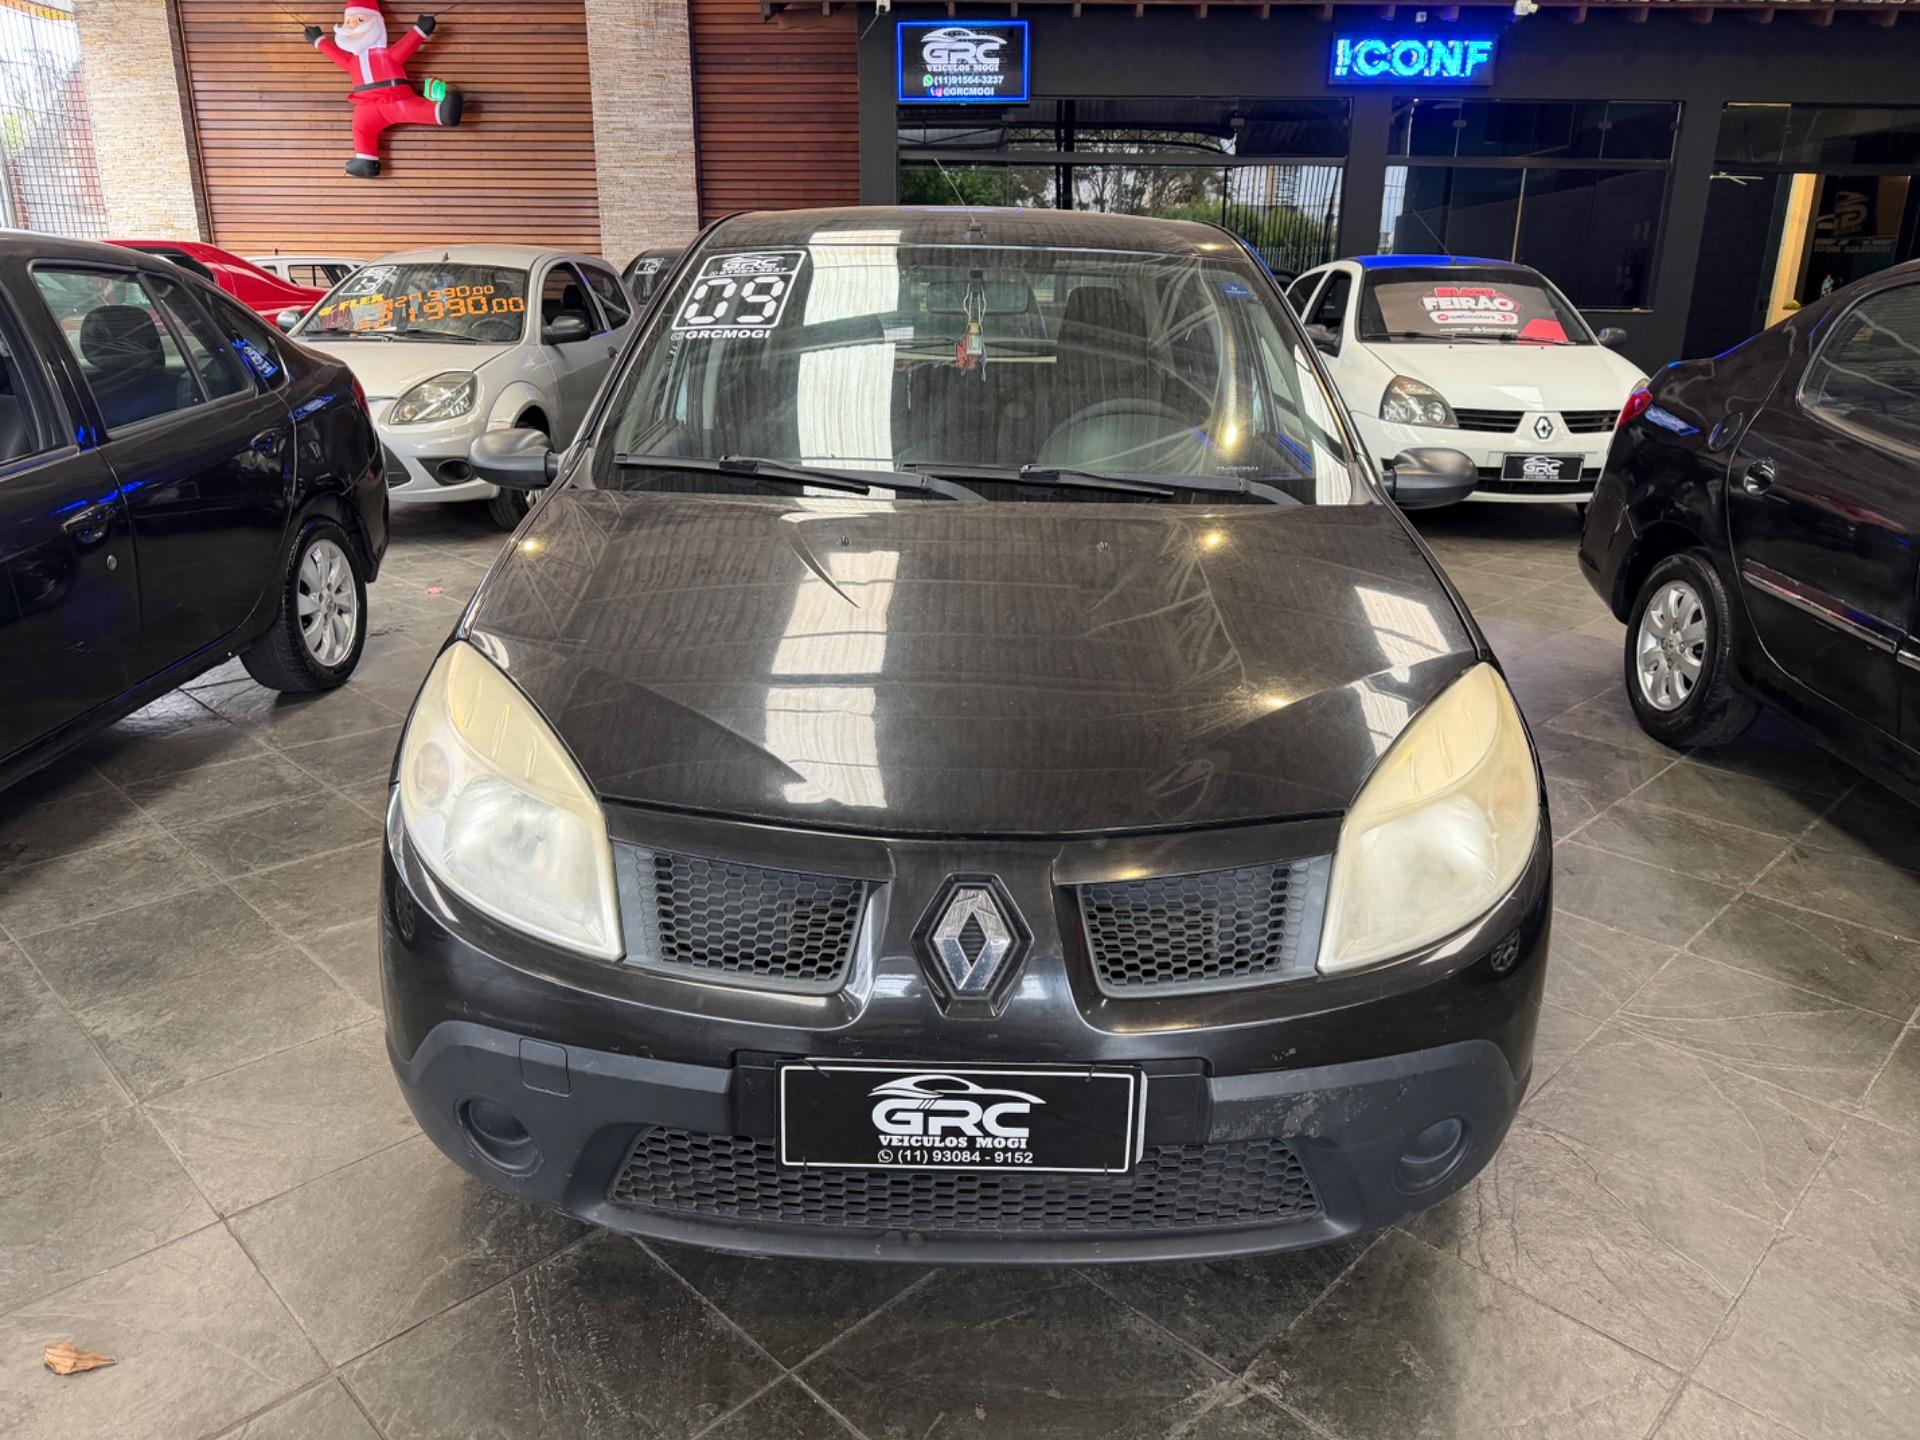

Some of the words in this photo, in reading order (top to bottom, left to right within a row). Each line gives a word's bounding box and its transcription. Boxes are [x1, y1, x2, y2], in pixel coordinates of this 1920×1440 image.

[923, 42, 1000, 64] GRC
[684, 276, 785, 324] 09
[671, 330, 771, 340] @GRCMOGI
[1522, 463, 1560, 473] GRC
[872, 1098, 1031, 1138] GRC
[878, 1135, 968, 1149] VEICULOS
[975, 1136, 1028, 1149] MOGI
[897, 1149, 928, 1165] (11)
[932, 1150, 981, 1163] 93084
[994, 1151, 1033, 1164] 9152
